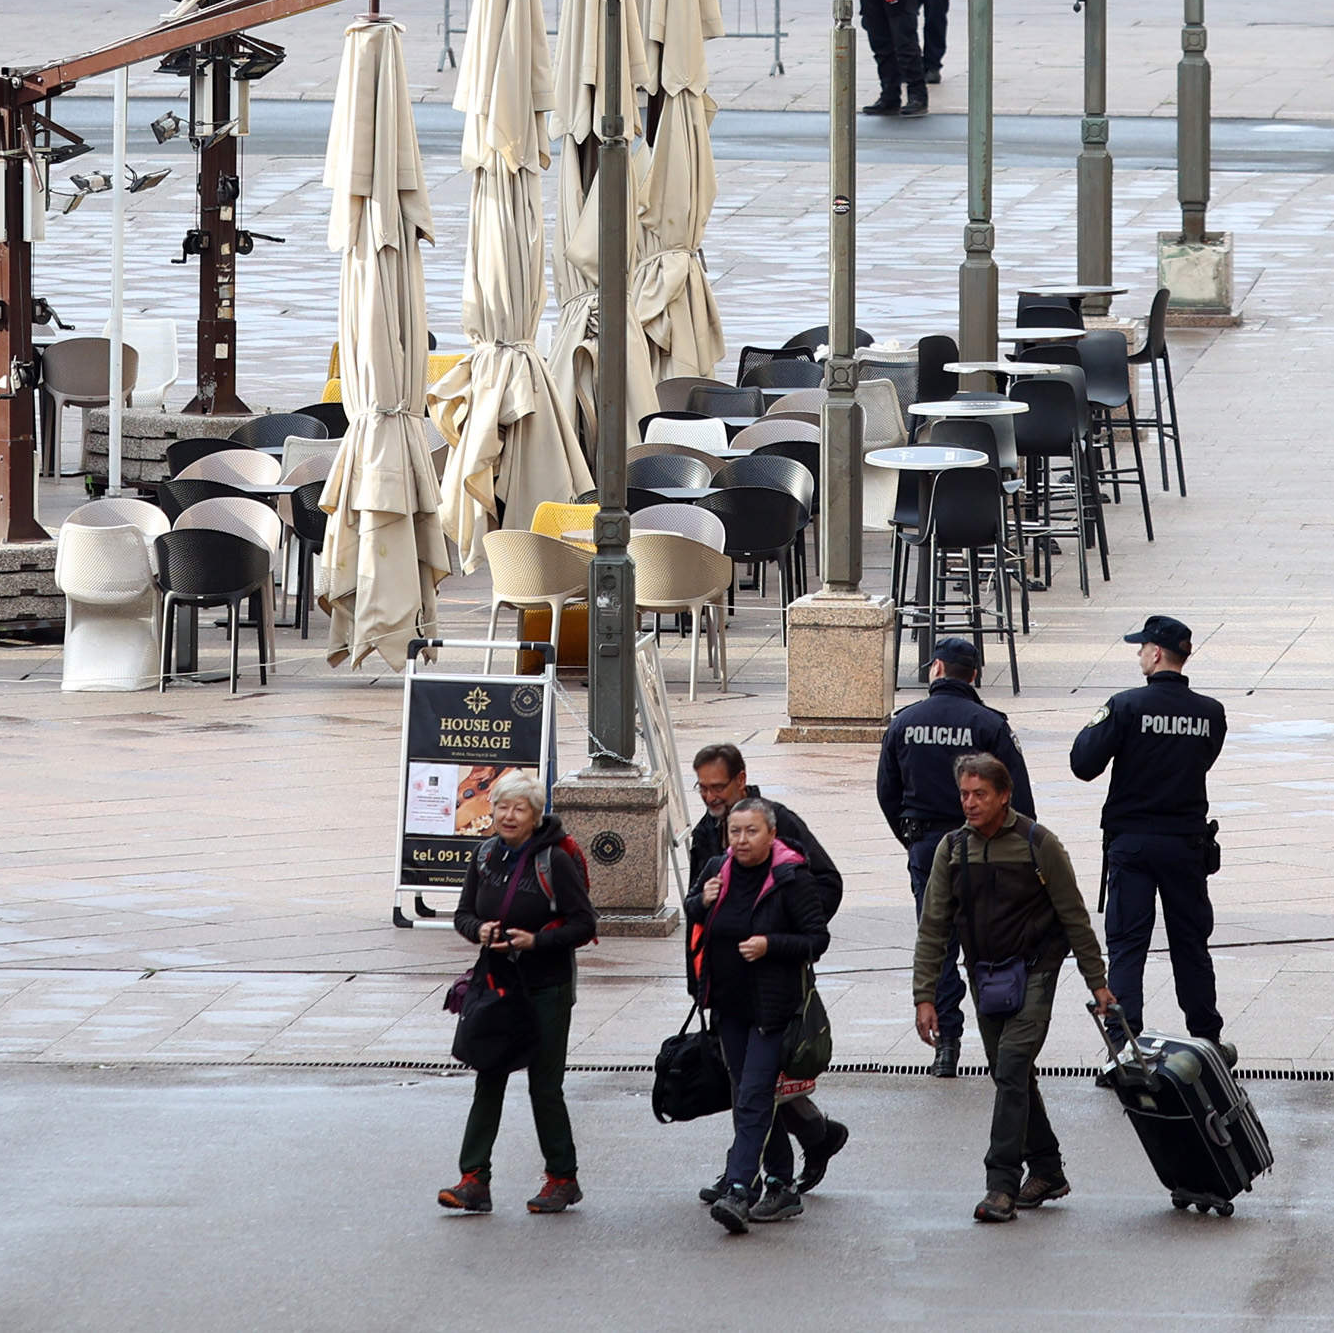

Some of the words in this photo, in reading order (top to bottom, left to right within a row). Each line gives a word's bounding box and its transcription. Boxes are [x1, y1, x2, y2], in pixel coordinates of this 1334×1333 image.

[440, 717, 490, 732] HOUSE
[492, 720, 512, 733] OF
[1141, 715, 1210, 737] POLICIJA
[439, 734, 511, 749] MASSAGE
[904, 726, 973, 747] POLICIJA
[413, 848, 435, 861] tel.
[437, 850, 460, 862] 091
